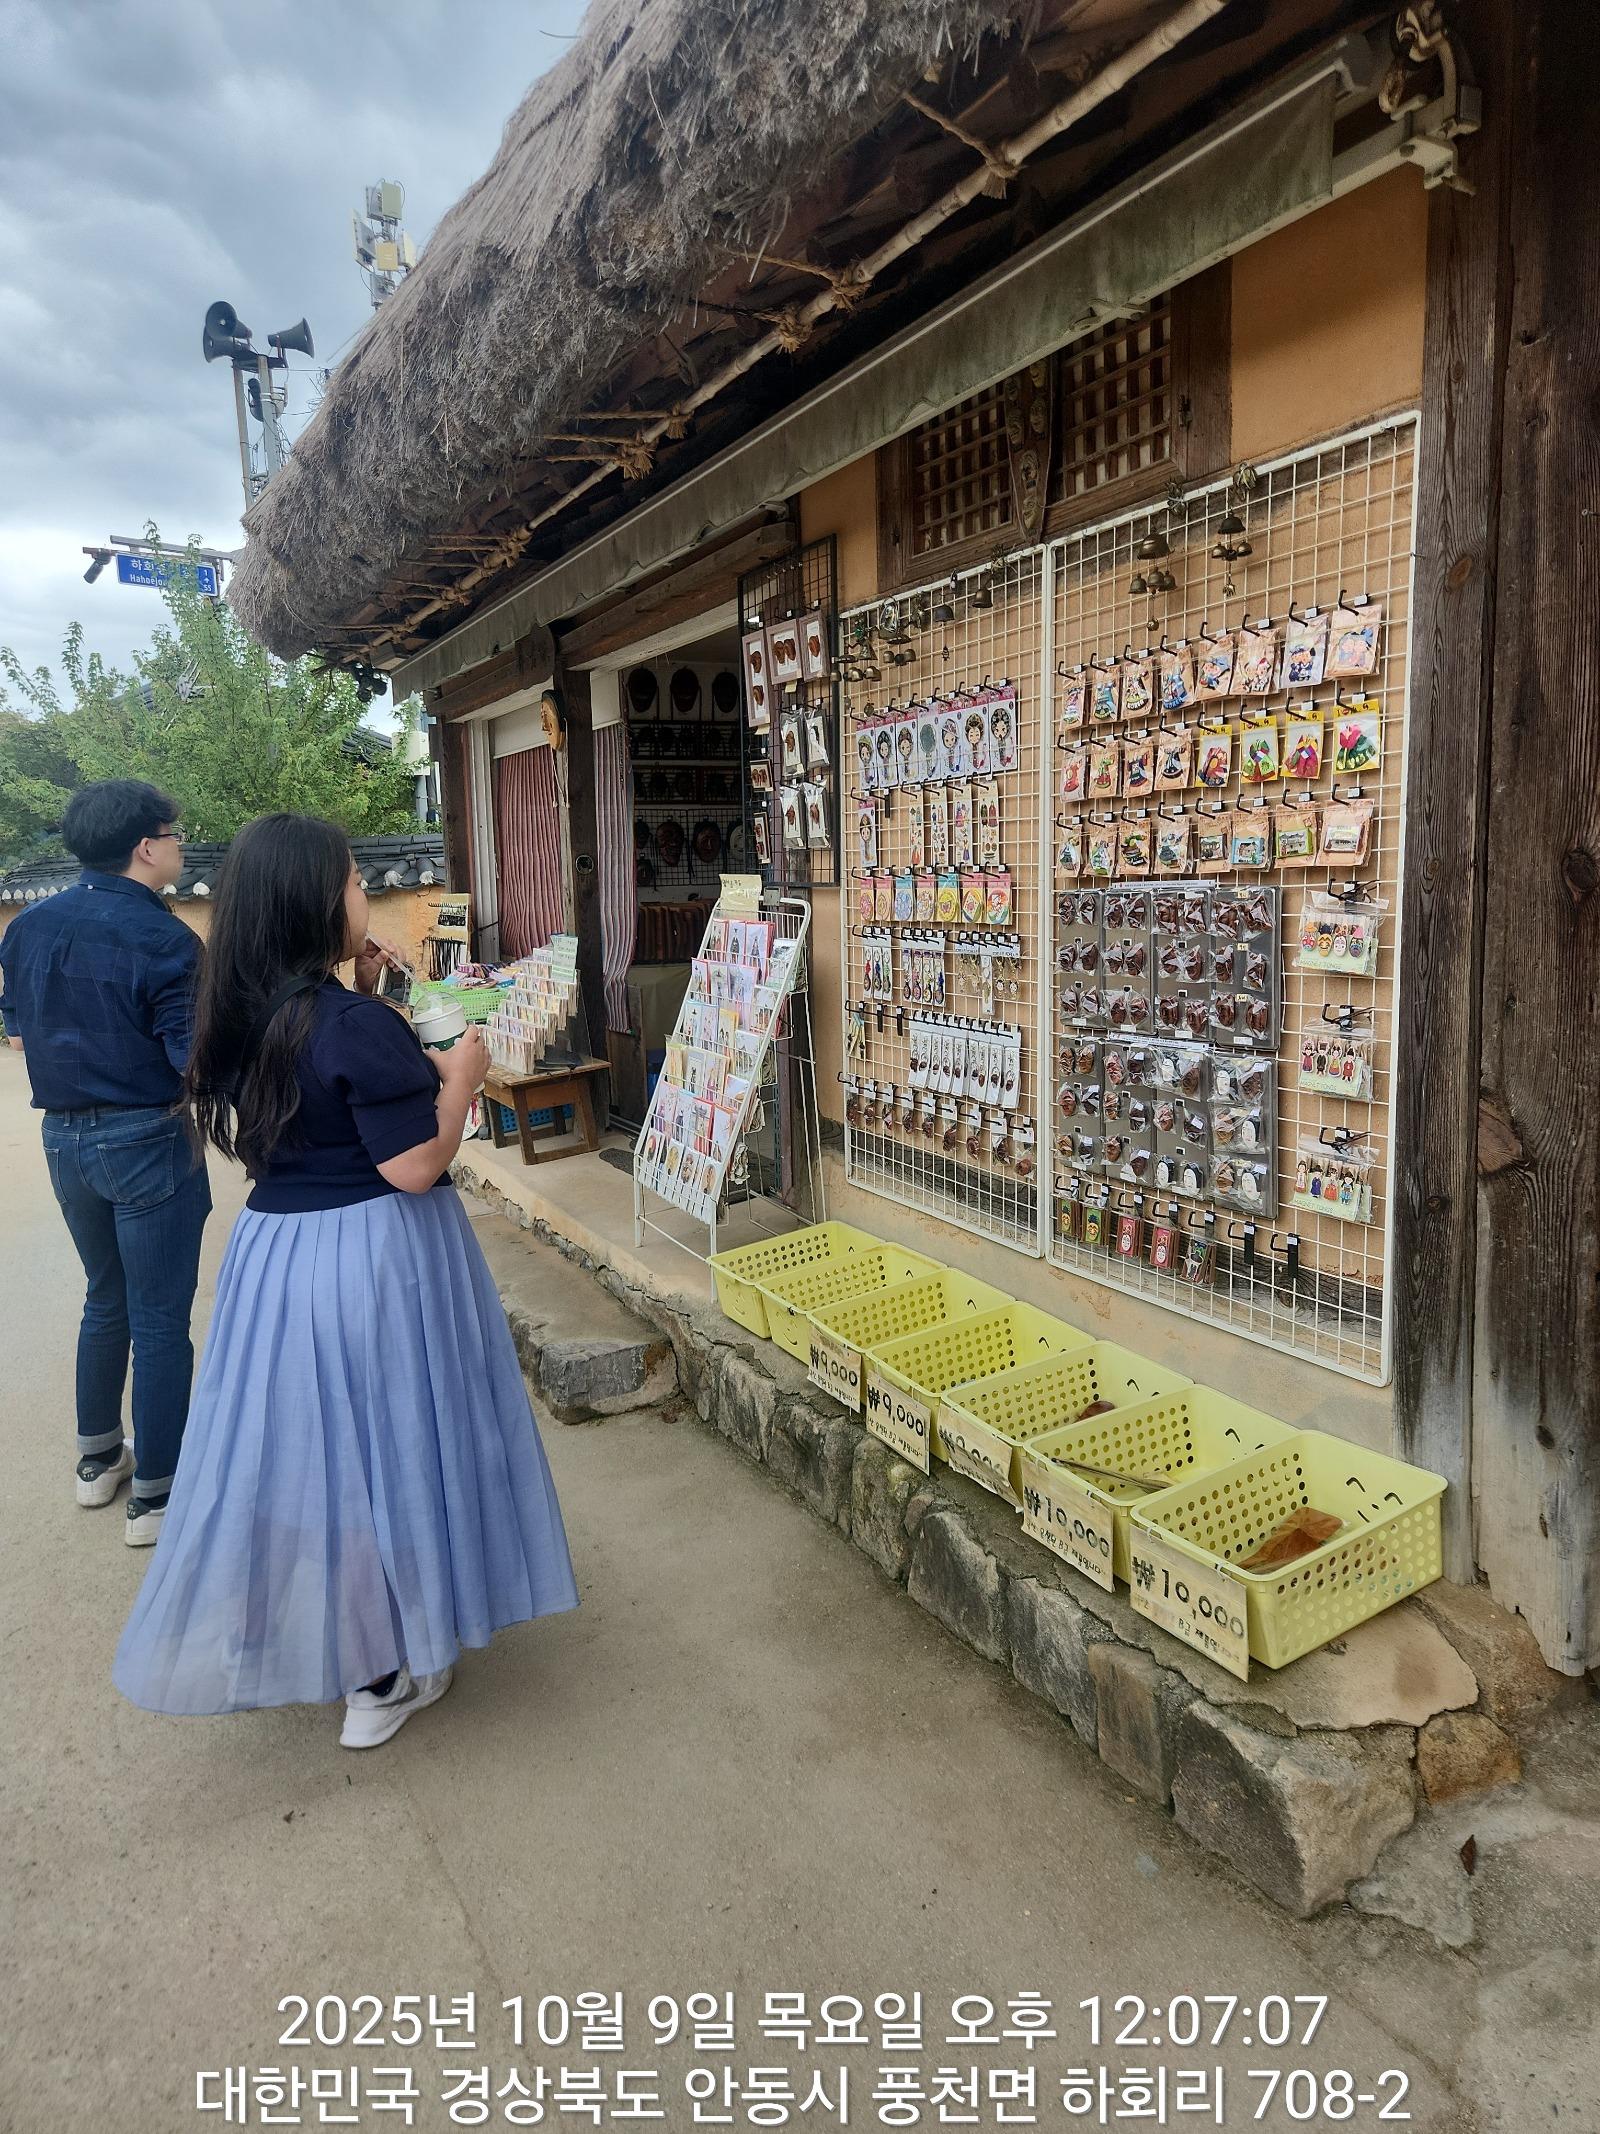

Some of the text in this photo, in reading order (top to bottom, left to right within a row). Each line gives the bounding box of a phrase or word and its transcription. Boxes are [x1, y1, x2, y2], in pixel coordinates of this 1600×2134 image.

[867, 1384, 924, 1437] ₩9,000
[1023, 1485, 1110, 1558] ₩10,000
[1131, 1555, 1244, 1640] ₩10,000
